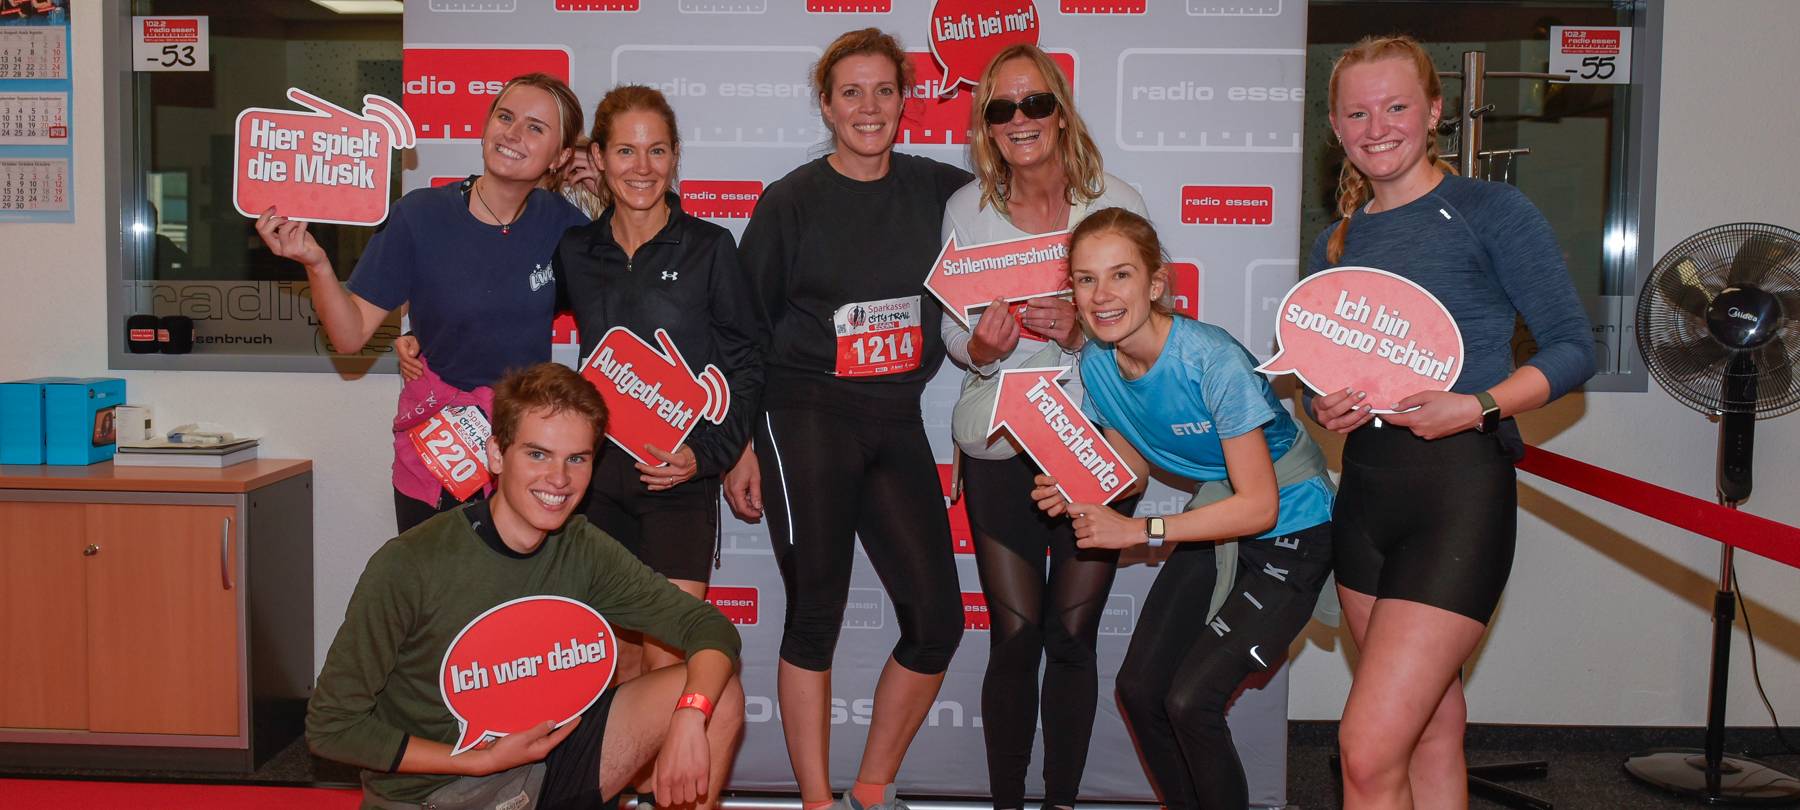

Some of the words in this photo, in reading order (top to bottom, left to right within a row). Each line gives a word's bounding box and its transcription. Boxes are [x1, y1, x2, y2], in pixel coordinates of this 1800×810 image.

[935, 16, 976, 42] Läuft
[978, 10, 1002, 38] bei
[1005, 5, 1035, 32] mir!
[146, 44, 196, 67] -53
[1565, 56, 1616, 79] -55
[402, 75, 456, 95] dio
[1132, 81, 1214, 101] radio
[1228, 86, 1305, 102] esse
[250, 118, 304, 151] Hier
[312, 127, 381, 161] spielt
[247, 152, 287, 182] die
[295, 154, 376, 189] Musik
[684, 191, 717, 200] radio
[1185, 197, 1220, 206] radio
[868, 302, 911, 315] Sparkassen
[1334, 290, 1371, 324] Ich
[1372, 304, 1410, 339] bin
[1727, 306, 1758, 322] Midea
[196, 334, 273, 345] senbruch
[852, 332, 914, 365] 1214
[1285, 303, 1377, 354] soooooo
[1377, 338, 1456, 382] schön!
[591, 346, 693, 431] Aufgedreht
[467, 410, 490, 438] Sparka
[1025, 376, 1120, 492] Tratschtante
[1171, 420, 1212, 436] ETUF
[419, 416, 478, 482] 1220
[1140, 497, 1185, 514] adi
[1210, 537, 1300, 637] NIKE
[965, 605, 988, 613] ess
[1103, 608, 1128, 616] sen
[450, 661, 489, 693] Ich
[493, 655, 543, 685] war
[547, 632, 607, 672] dabei
